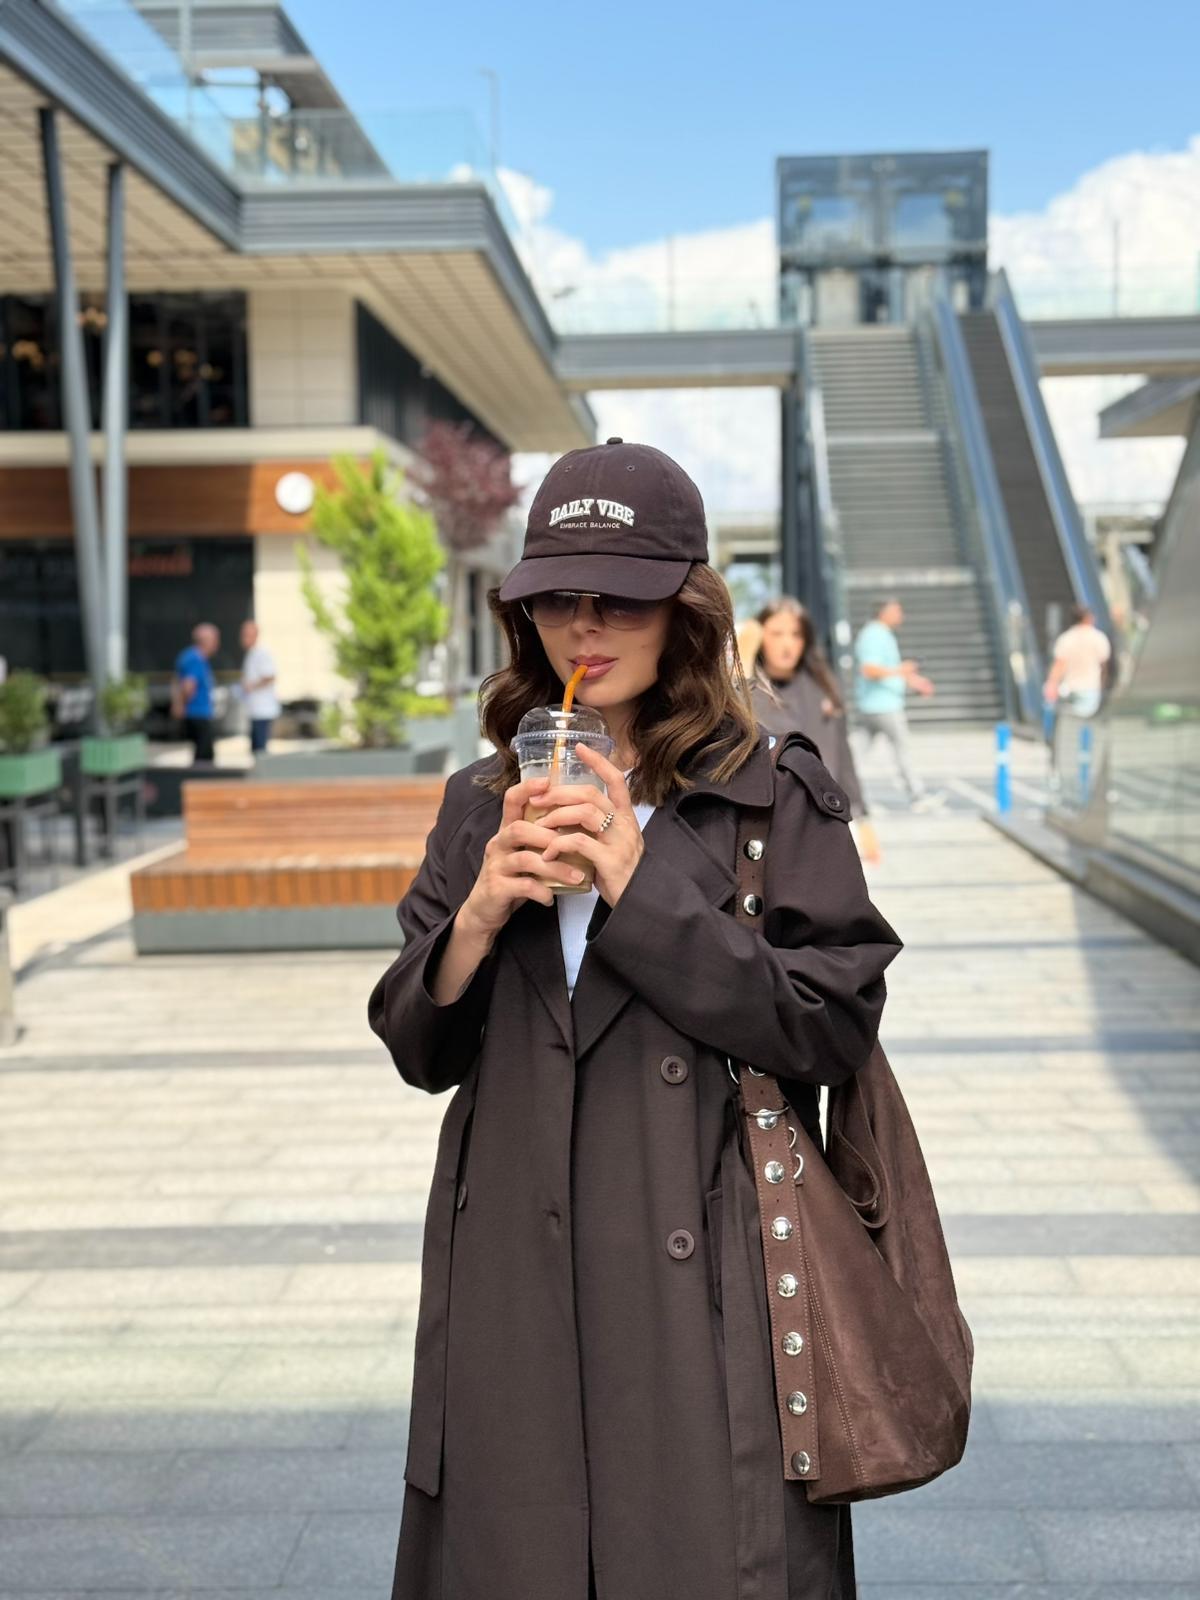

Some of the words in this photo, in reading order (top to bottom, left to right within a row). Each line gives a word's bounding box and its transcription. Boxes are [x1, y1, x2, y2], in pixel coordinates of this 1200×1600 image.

[549, 498, 595, 527] DAILY
[596, 499, 635, 527] VIBE
[560, 521, 588, 529] EMBRACE
[589, 521, 621, 529] BALANCE
